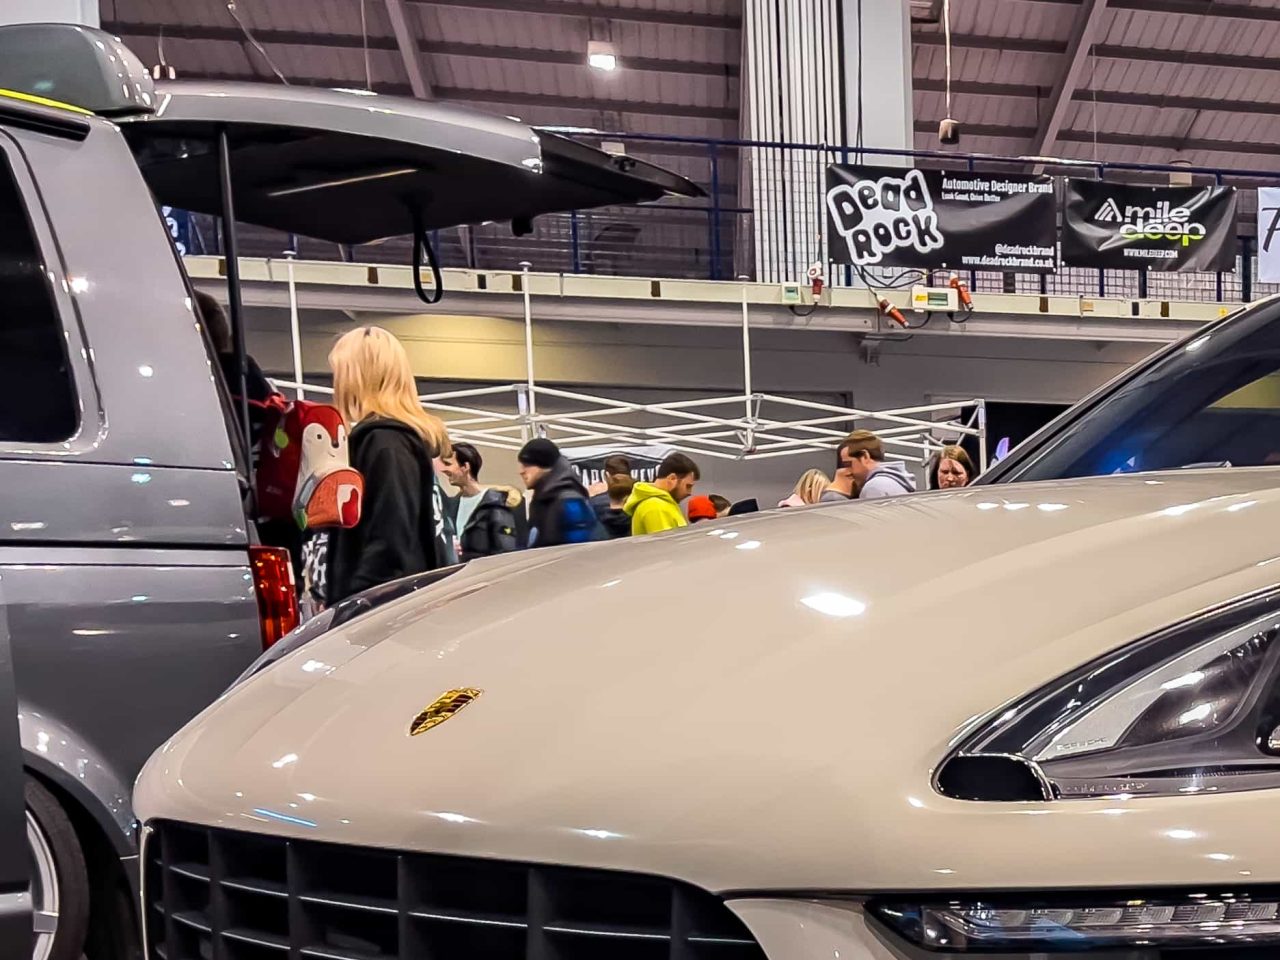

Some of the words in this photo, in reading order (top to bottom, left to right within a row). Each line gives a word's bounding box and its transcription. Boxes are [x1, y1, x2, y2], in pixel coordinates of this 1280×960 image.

[942, 178, 989, 191] Automotive
[991, 180, 1027, 194] Designer
[1028, 182, 1053, 193] Brand
[829, 171, 931, 234] Dead
[1124, 201, 1191, 223] mile
[1120, 218, 1206, 246] deep
[994, 244, 1054, 256] @deadrockbrand
